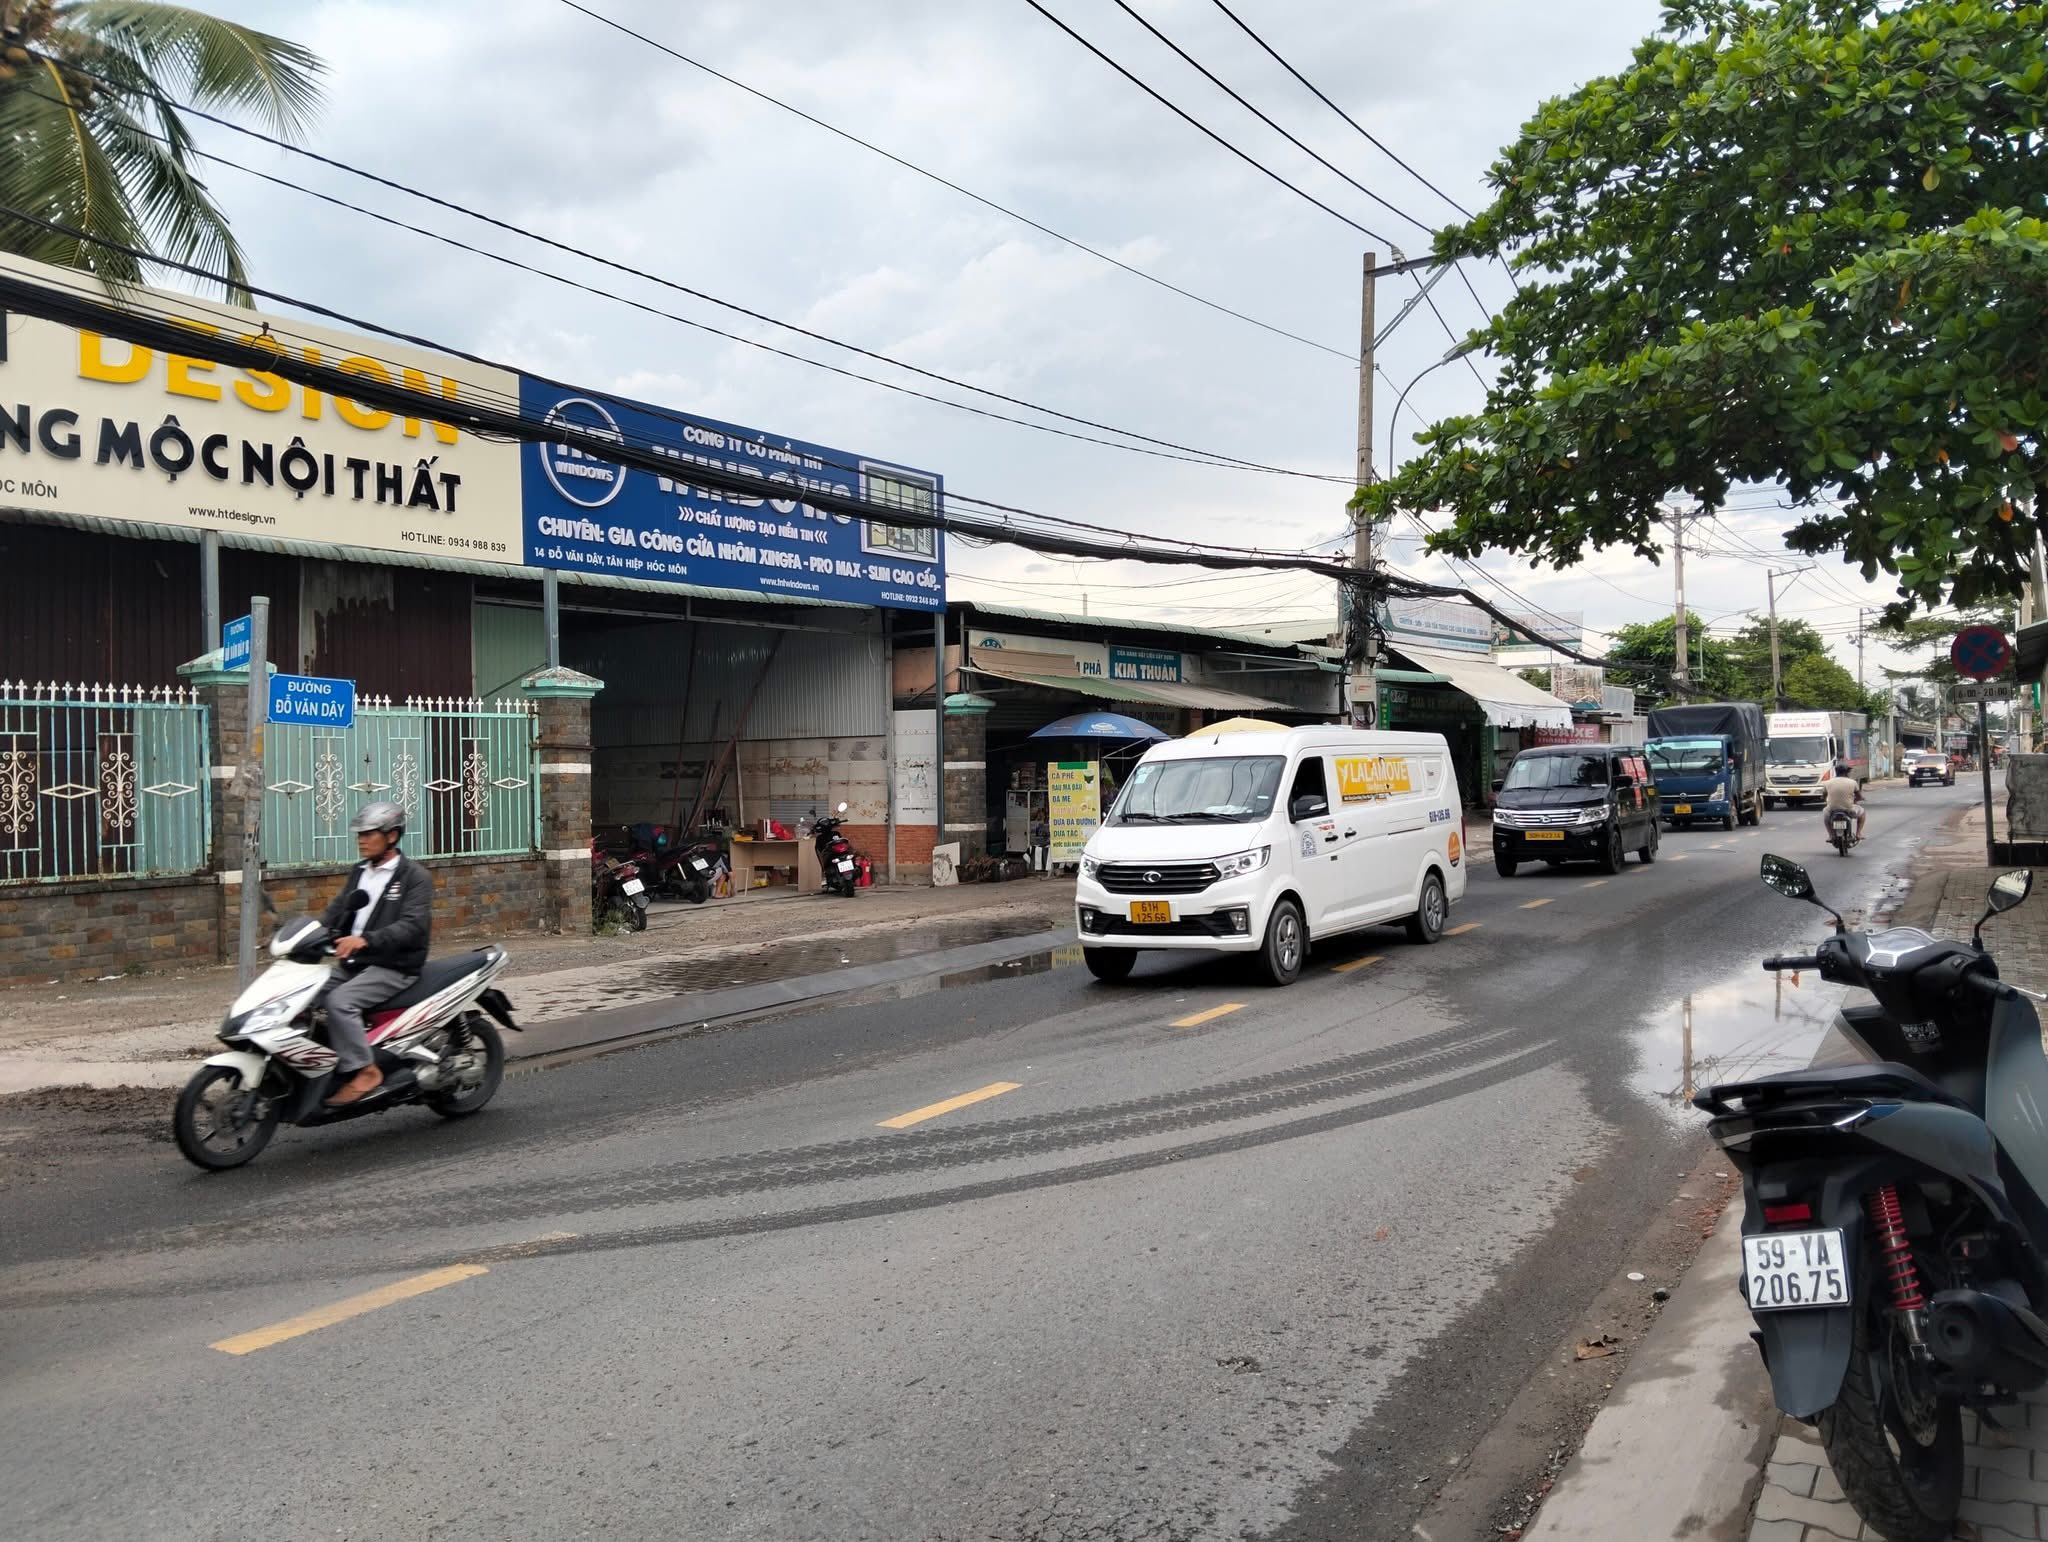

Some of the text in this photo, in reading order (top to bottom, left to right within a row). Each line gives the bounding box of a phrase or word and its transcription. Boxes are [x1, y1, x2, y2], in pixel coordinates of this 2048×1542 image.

[727, 437, 742, 453] TY
[95, 414, 229, 482] MỘC
[240, 436, 335, 501] NỘI
[344, 455, 462, 513] THẤT
[554, 460, 614, 482] WINDOWS
[21, 479, 57, 499] MÔN
[188, 506, 276, 525] www.htdesign.vn
[695, 508, 722, 526] CHẤT
[724, 515, 757, 533] LƯỢNG
[758, 521, 776, 538] TẠO
[800, 528, 814, 542] TIN
[401, 531, 506, 552] HOTLINE: 0934 988 839
[538, 516, 605, 543] CHUYÊN:
[608, 526, 637, 548] GIA
[639, 528, 684, 554] CÔNG
[686, 533, 715, 558] CỬA
[718, 540, 756, 564] NHÔM
[759, 548, 802, 570] XINGFA
[892, 569, 915, 586] CAO
[534, 546, 544, 558] 14
[548, 545, 563, 560] ĐỖ
[566, 549, 584, 563] VĂN
[606, 555, 623, 569] TÂN
[625, 557, 643, 571] HIỆP
[646, 559, 665, 573] HÓC
[668, 562, 687, 575] MÔN
[1114, 662, 1138, 679] KIM
[287, 680, 332, 695] ĐƯỜNG
[275, 694, 345, 720] ĐỖ VĂN DẬY
[1575, 727, 1595, 738] XE
[1351, 760, 1409, 783] LALAMOVE
[1757, 1234, 1831, 1269] 59-YA
[1753, 1269, 1842, 1306] 206.75
